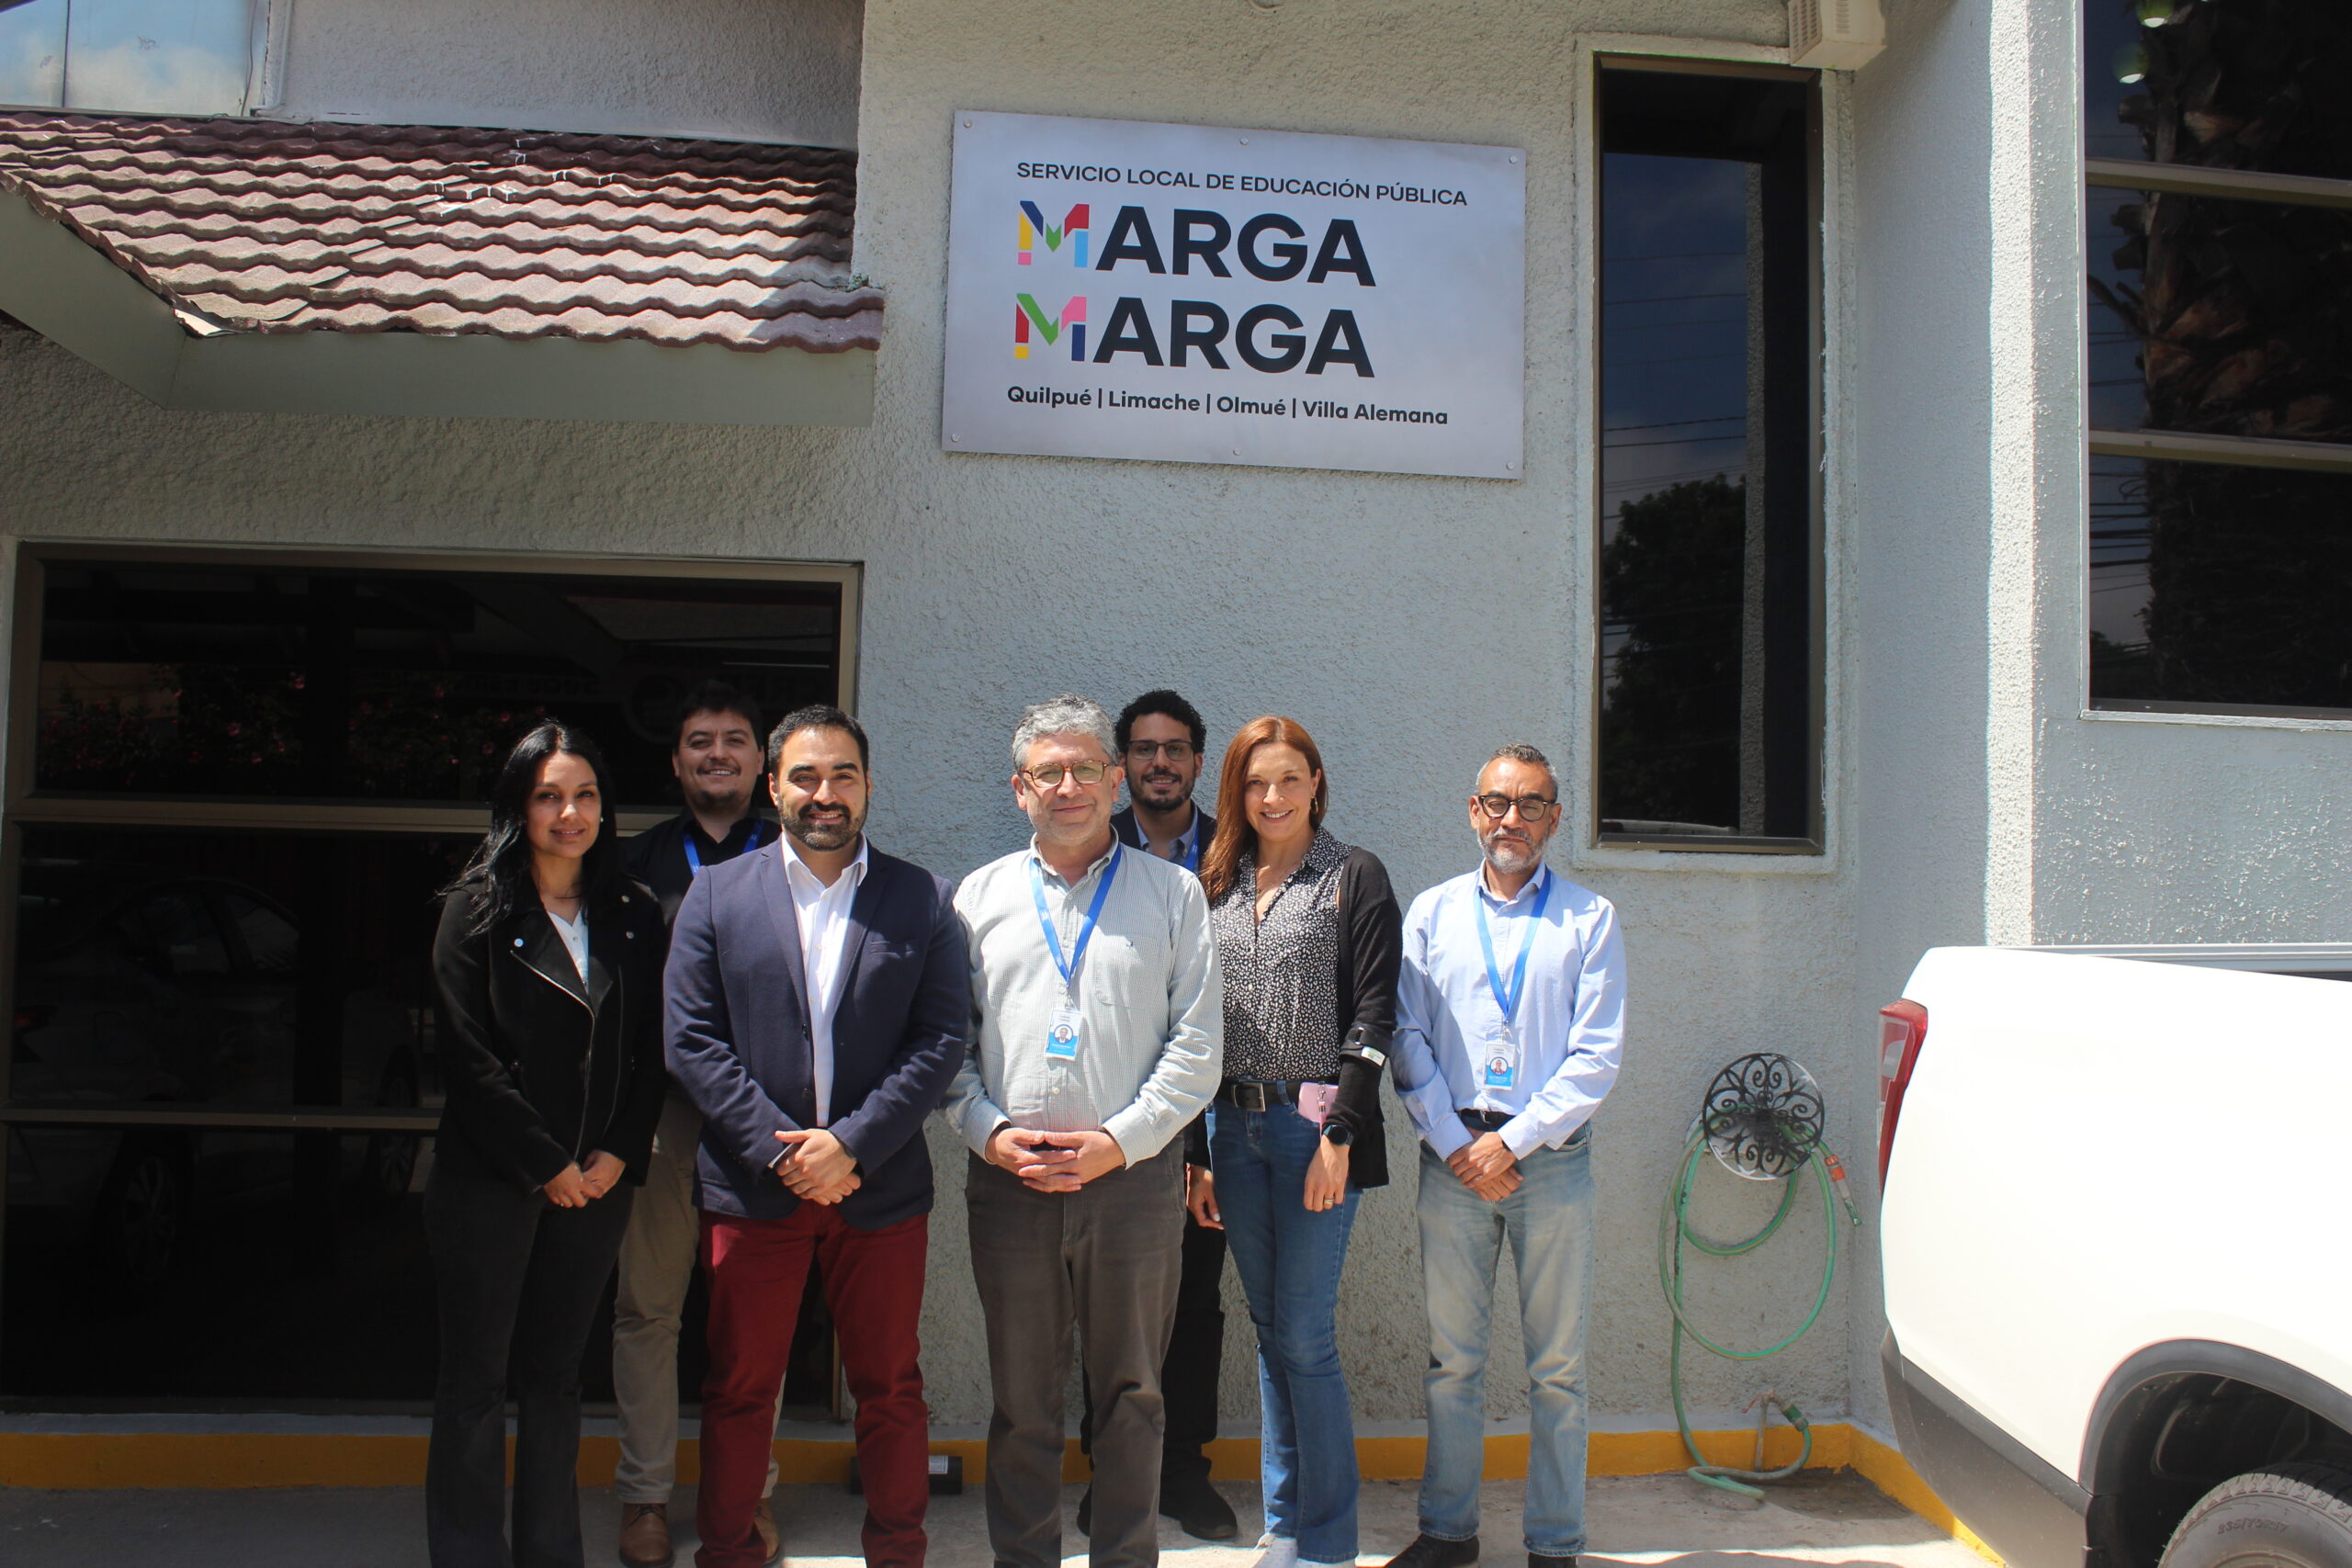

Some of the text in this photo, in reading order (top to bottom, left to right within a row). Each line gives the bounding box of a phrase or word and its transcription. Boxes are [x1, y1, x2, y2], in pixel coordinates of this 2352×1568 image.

[1016, 161, 1468, 207] SERVICIO LOCAL DE EDUCACIÓN PÚBLICA
[1018, 199, 1377, 288] MARGA
[1014, 292, 1375, 378] MARGA
[1007, 385, 1448, 425] Quilpué Limache Olmué Villa Alemana
